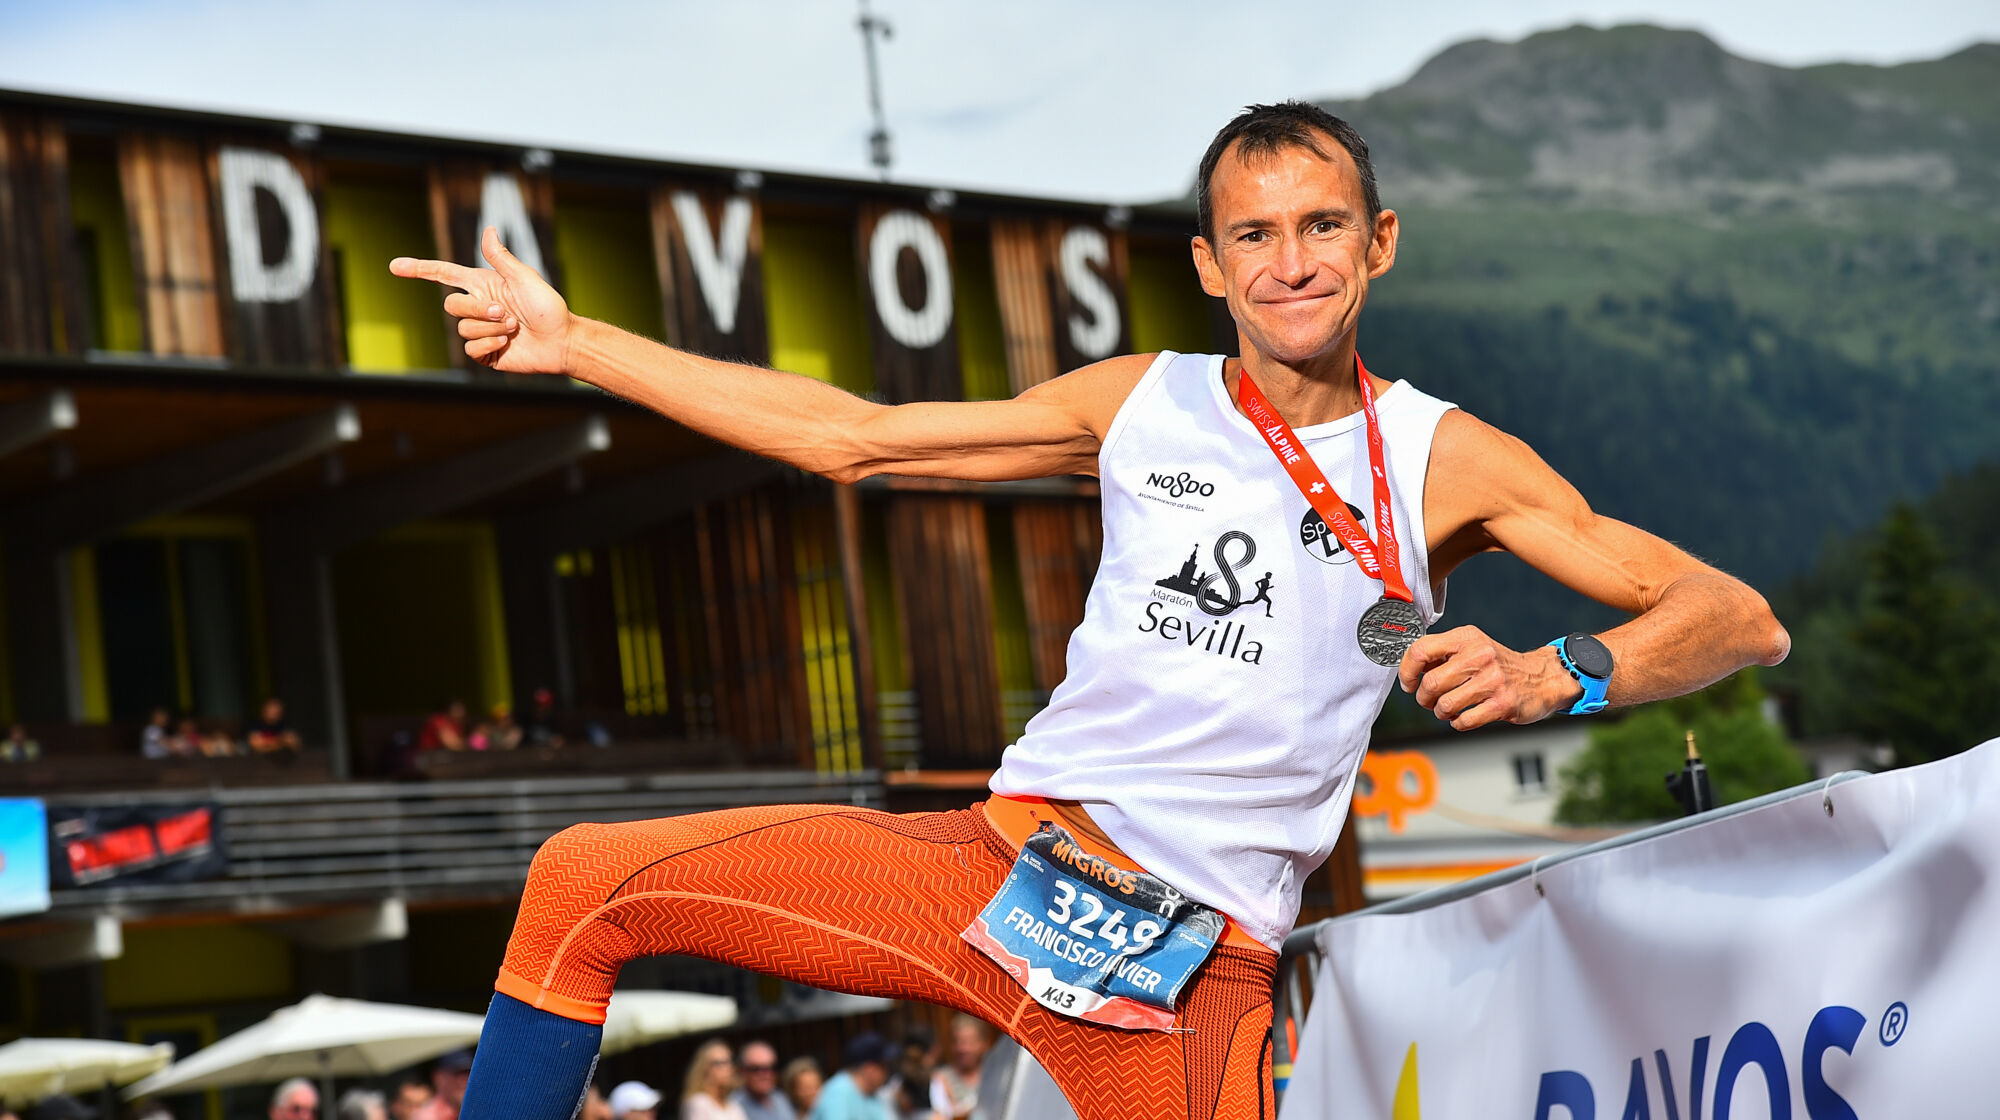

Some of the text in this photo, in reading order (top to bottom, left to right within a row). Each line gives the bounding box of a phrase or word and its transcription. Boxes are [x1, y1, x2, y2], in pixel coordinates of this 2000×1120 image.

[1246, 397, 1301, 465] SWISSALPINE
[1328, 511, 1381, 573] SWISSALPINE
[1150, 588, 1193, 609] Maratón
[1138, 601, 1263, 666] Sevilla
[1051, 840, 1138, 895] MIGROS
[1003, 905, 1107, 968] FRANCISCO
[1047, 880, 1162, 956] 3249
[1040, 986, 1076, 1009] K43
